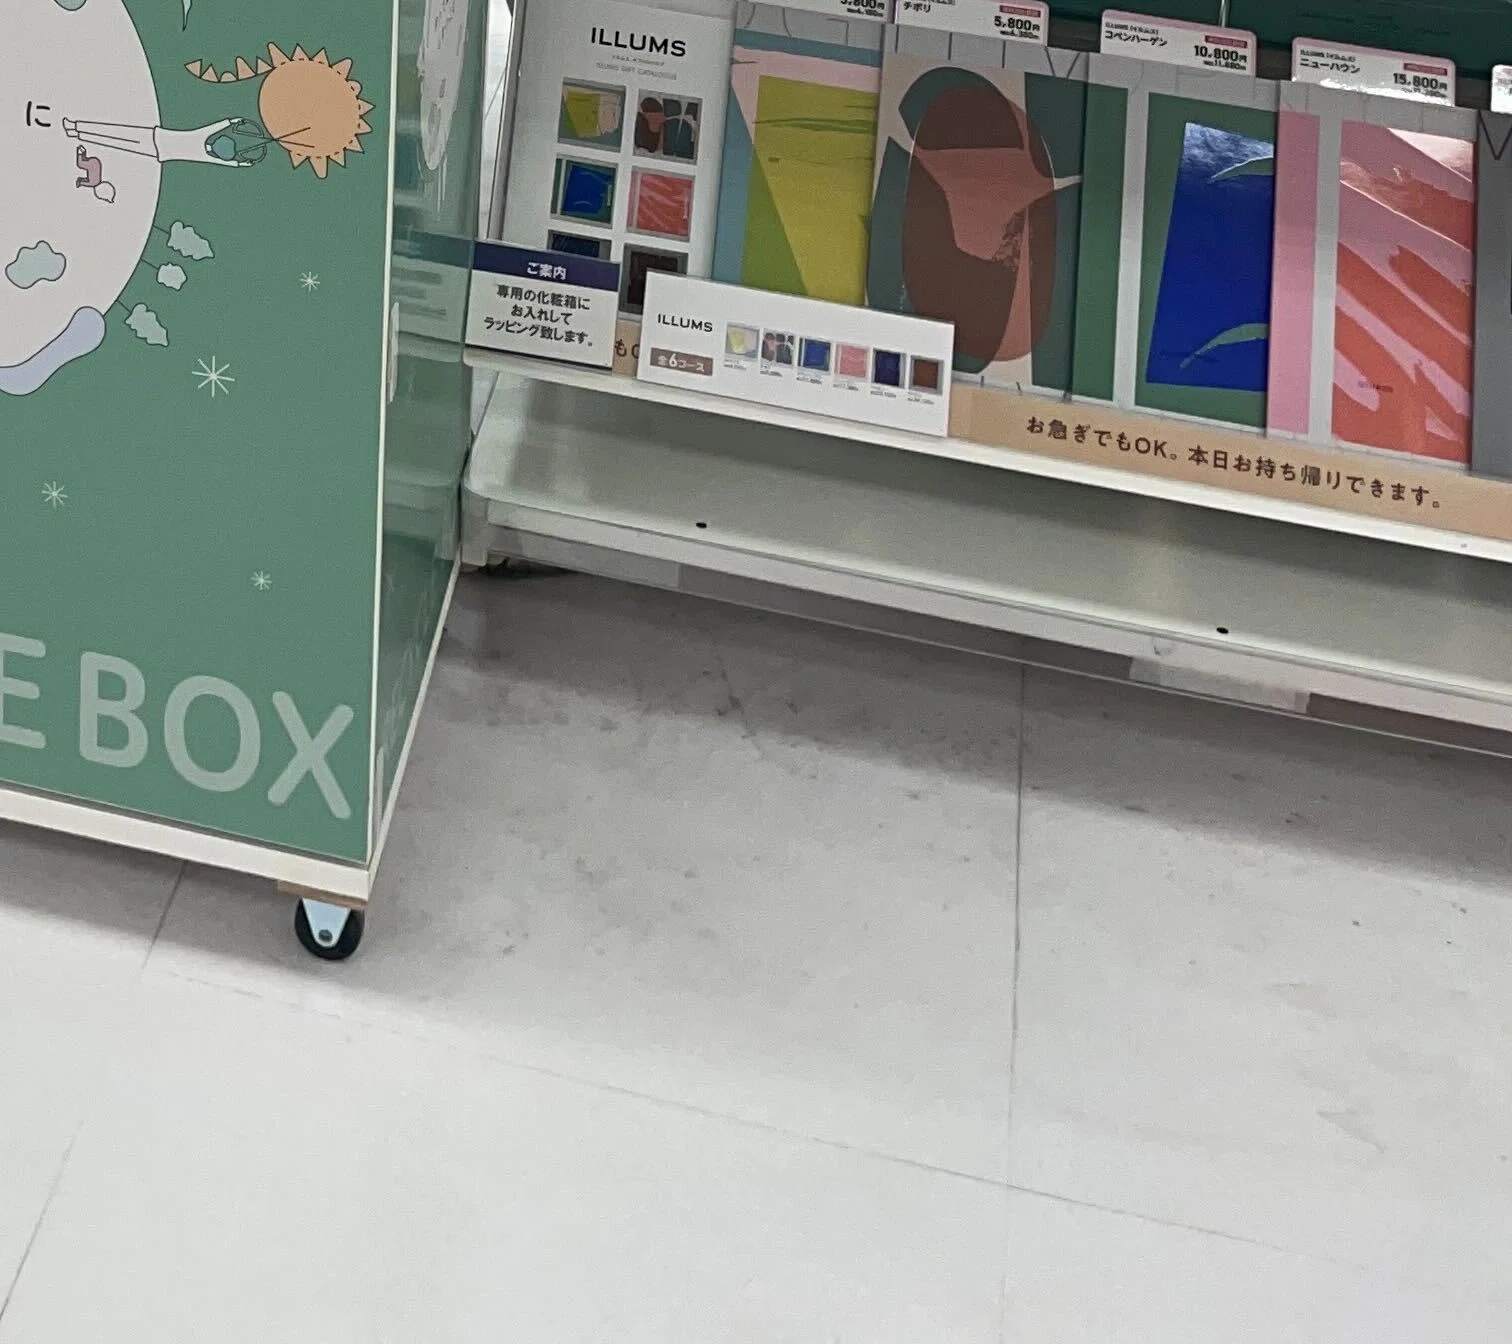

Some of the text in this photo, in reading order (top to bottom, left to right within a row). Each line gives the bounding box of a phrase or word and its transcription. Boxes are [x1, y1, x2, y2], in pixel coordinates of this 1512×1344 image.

[994, 15, 1040, 32] 5,800円
[591, 27, 686, 57] ILLUMS
[1105, 30, 1168, 48] コペンハーゲン
[1300, 58, 1360, 74] ニューハウン
[527, 261, 567, 281] ご案内
[496, 283, 590, 311] 専用の化粧箱に
[510, 303, 573, 326] お入れして
[657, 313, 713, 333] ILLUMS
[483, 315, 594, 347] ラッピング致します。
[79, 649, 354, 820] BOX
